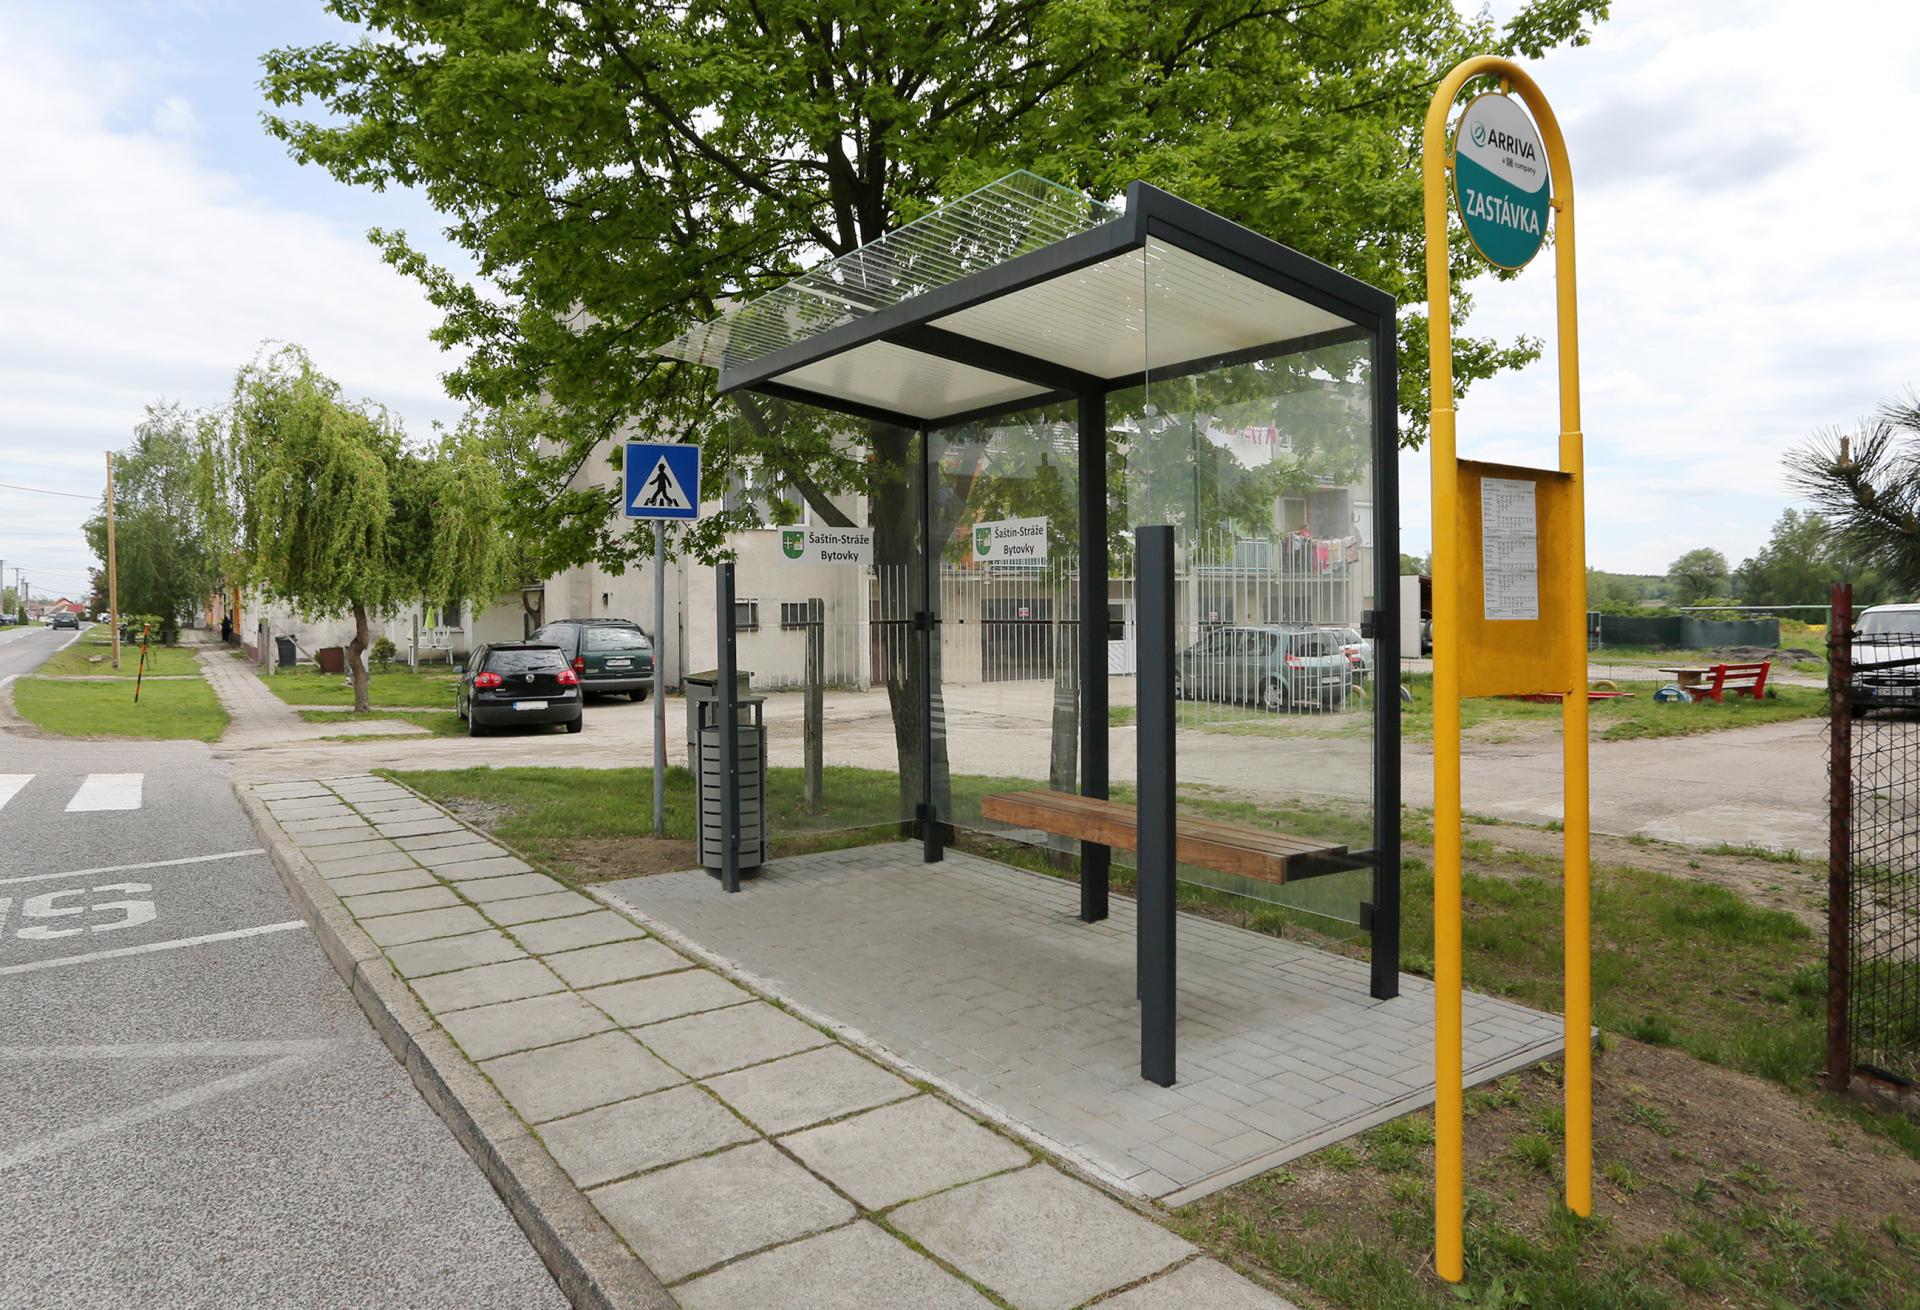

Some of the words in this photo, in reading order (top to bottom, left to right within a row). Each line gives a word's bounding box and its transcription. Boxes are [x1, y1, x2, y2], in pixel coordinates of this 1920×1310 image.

[1488, 129, 1536, 162] ARRIVA
[1514, 162, 1536, 176] company
[1466, 189, 1540, 236] ZASTÁVKA
[809, 532, 870, 545] Šaštín-Stráže
[994, 525, 1044, 539] Šaštín-Stráže
[821, 550, 859, 562] Bytovky
[1003, 543, 1035, 556] Bytovky
